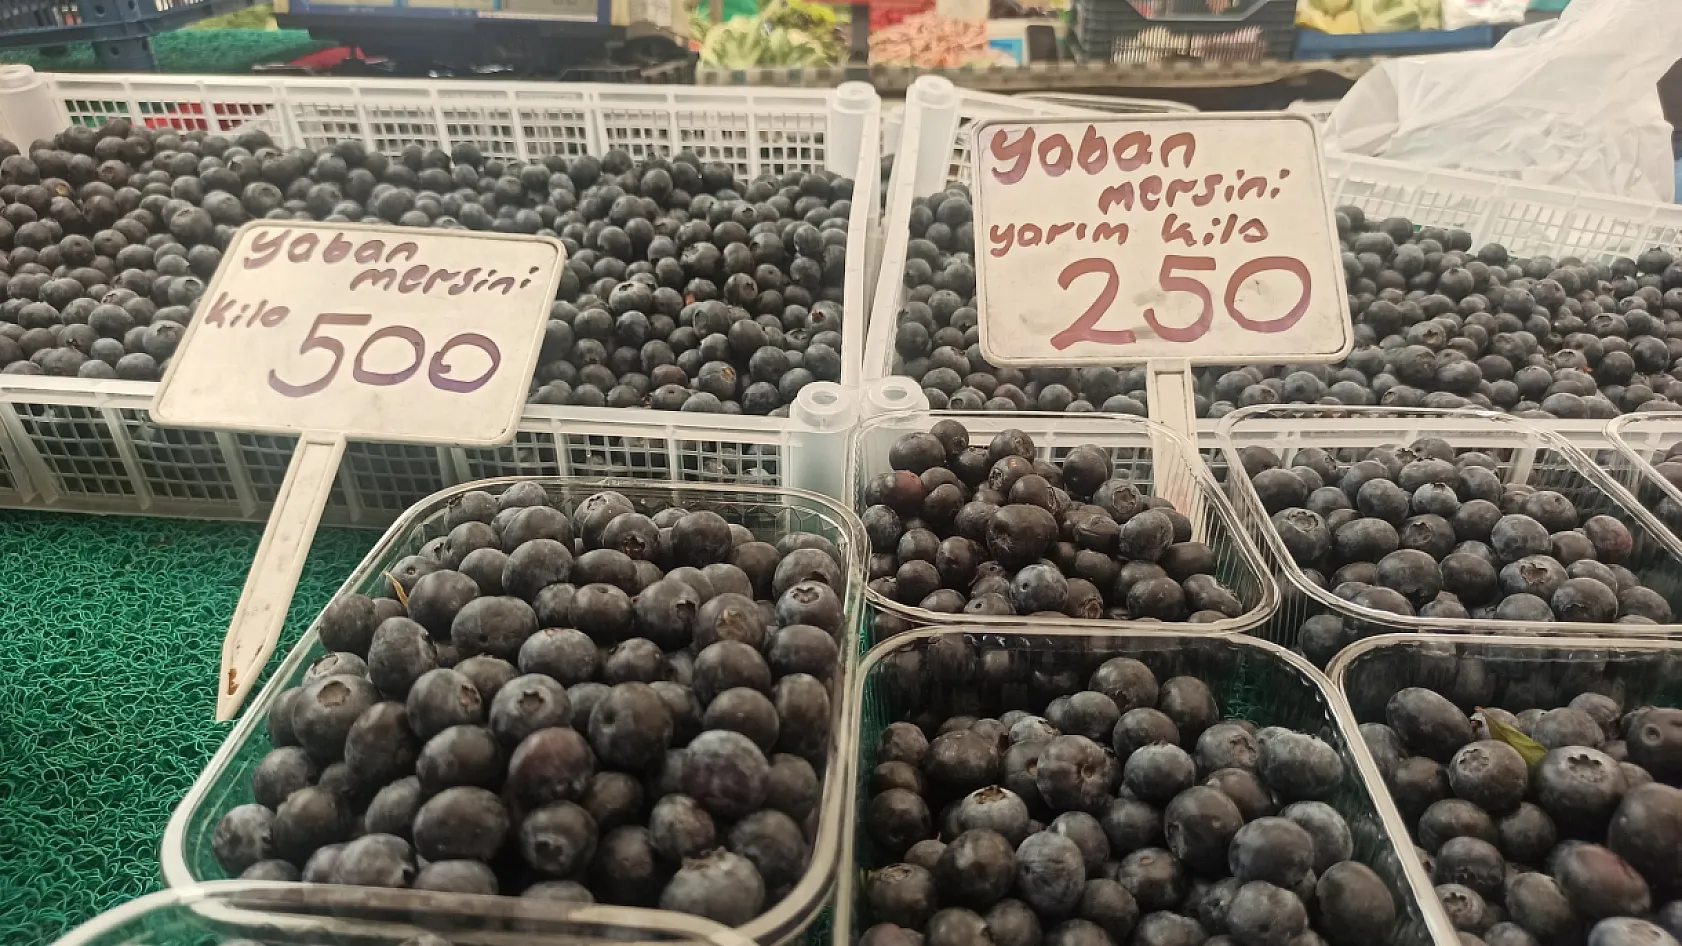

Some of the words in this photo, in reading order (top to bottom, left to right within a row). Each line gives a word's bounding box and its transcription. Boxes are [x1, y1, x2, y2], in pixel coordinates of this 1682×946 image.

[1098, 169, 1291, 215] mersini
[349, 264, 541, 296] mersini
[1050, 255, 1312, 350] 250
[268, 312, 501, 398] 500
